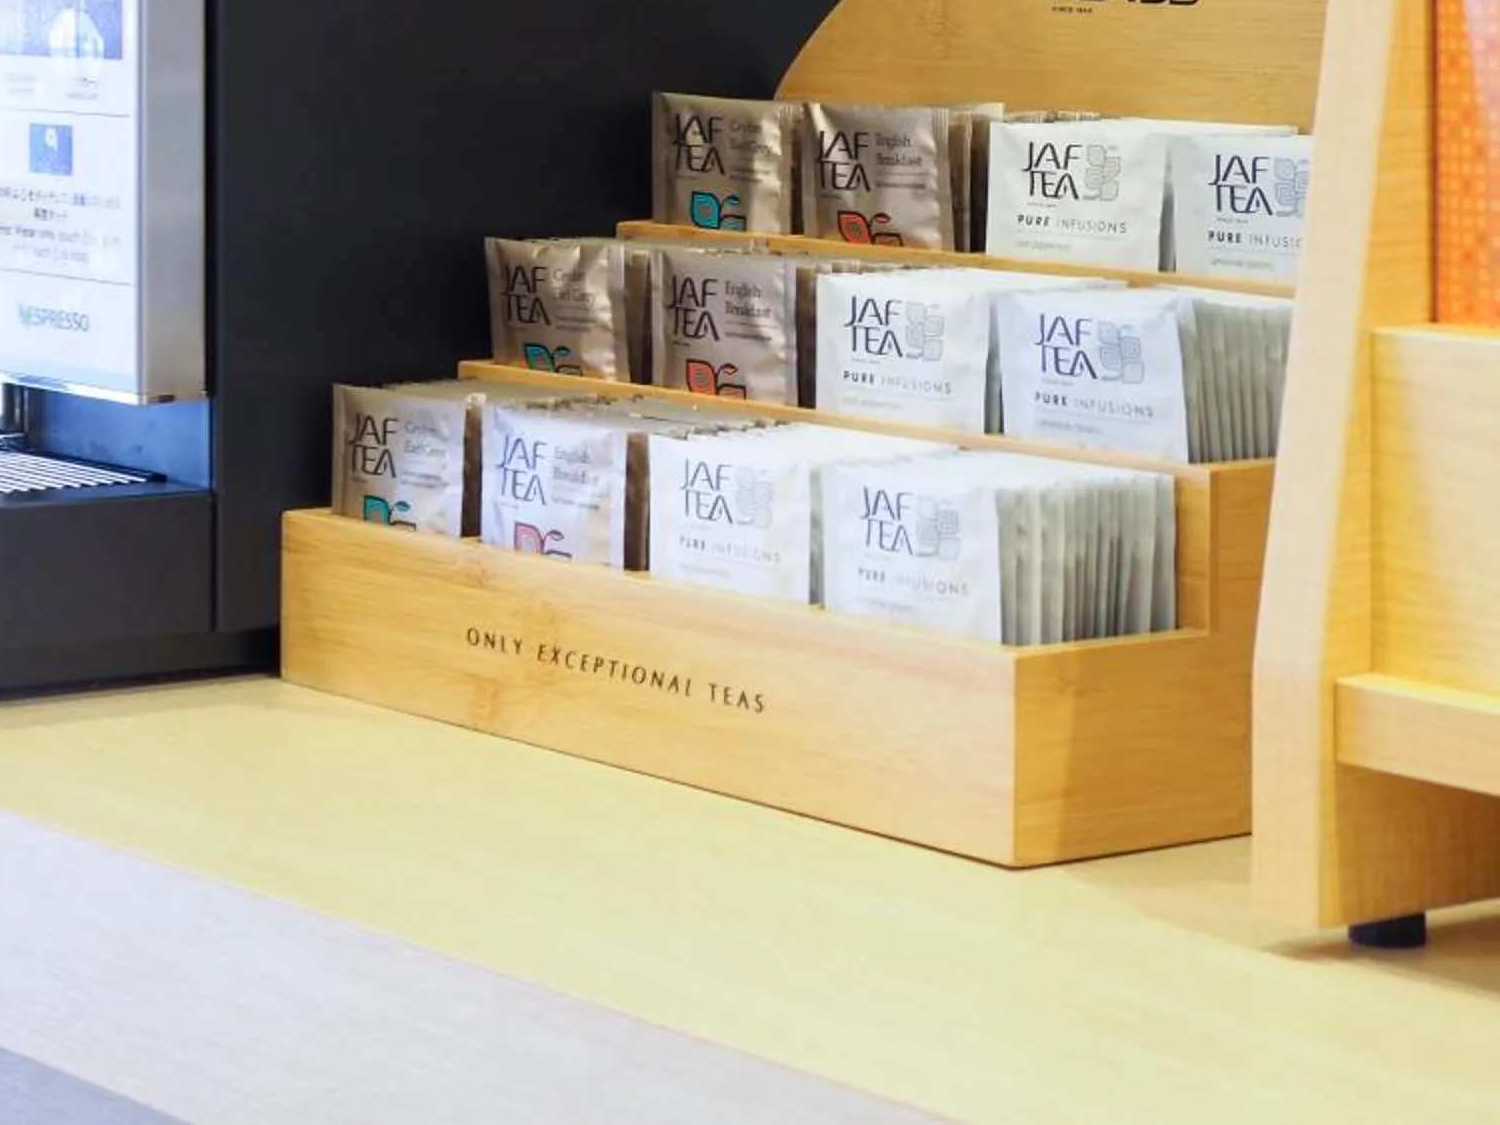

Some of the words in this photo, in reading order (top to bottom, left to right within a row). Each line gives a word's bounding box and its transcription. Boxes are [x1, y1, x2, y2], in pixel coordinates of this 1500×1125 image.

[675, 143, 725, 175] TEA
[1022, 141, 1082, 172] JAF
[1208, 154, 1269, 186] JAF
[818, 160, 871, 192] TEA
[1029, 169, 1079, 200] TEA
[1214, 183, 1273, 216] TEA
[1016, 214, 1050, 228] PURE
[1056, 218, 1127, 234] INFUSIONS
[1207, 230, 1242, 244] PURE
[504, 292, 551, 326] TEA
[672, 305, 721, 342] TEA
[843, 295, 902, 328] JAF
[851, 325, 903, 358] TEA
[1034, 313, 1092, 347] JAF
[843, 370, 875, 386] PURE
[1041, 344, 1098, 380] TEA
[1034, 391, 1068, 406] PURE
[347, 412, 399, 446] JAF
[352, 443, 397, 479] TEA
[497, 434, 548, 469] JAF
[501, 467, 547, 506] TEA
[680, 458, 733, 491] JAF
[685, 489, 733, 524] TEA
[860, 485, 914, 521] JAF
[865, 518, 914, 556] TEA
[466, 627, 523, 655] ONLY
[537, 643, 692, 697] EXCEPTIONAL
[708, 682, 766, 713] TEAS
